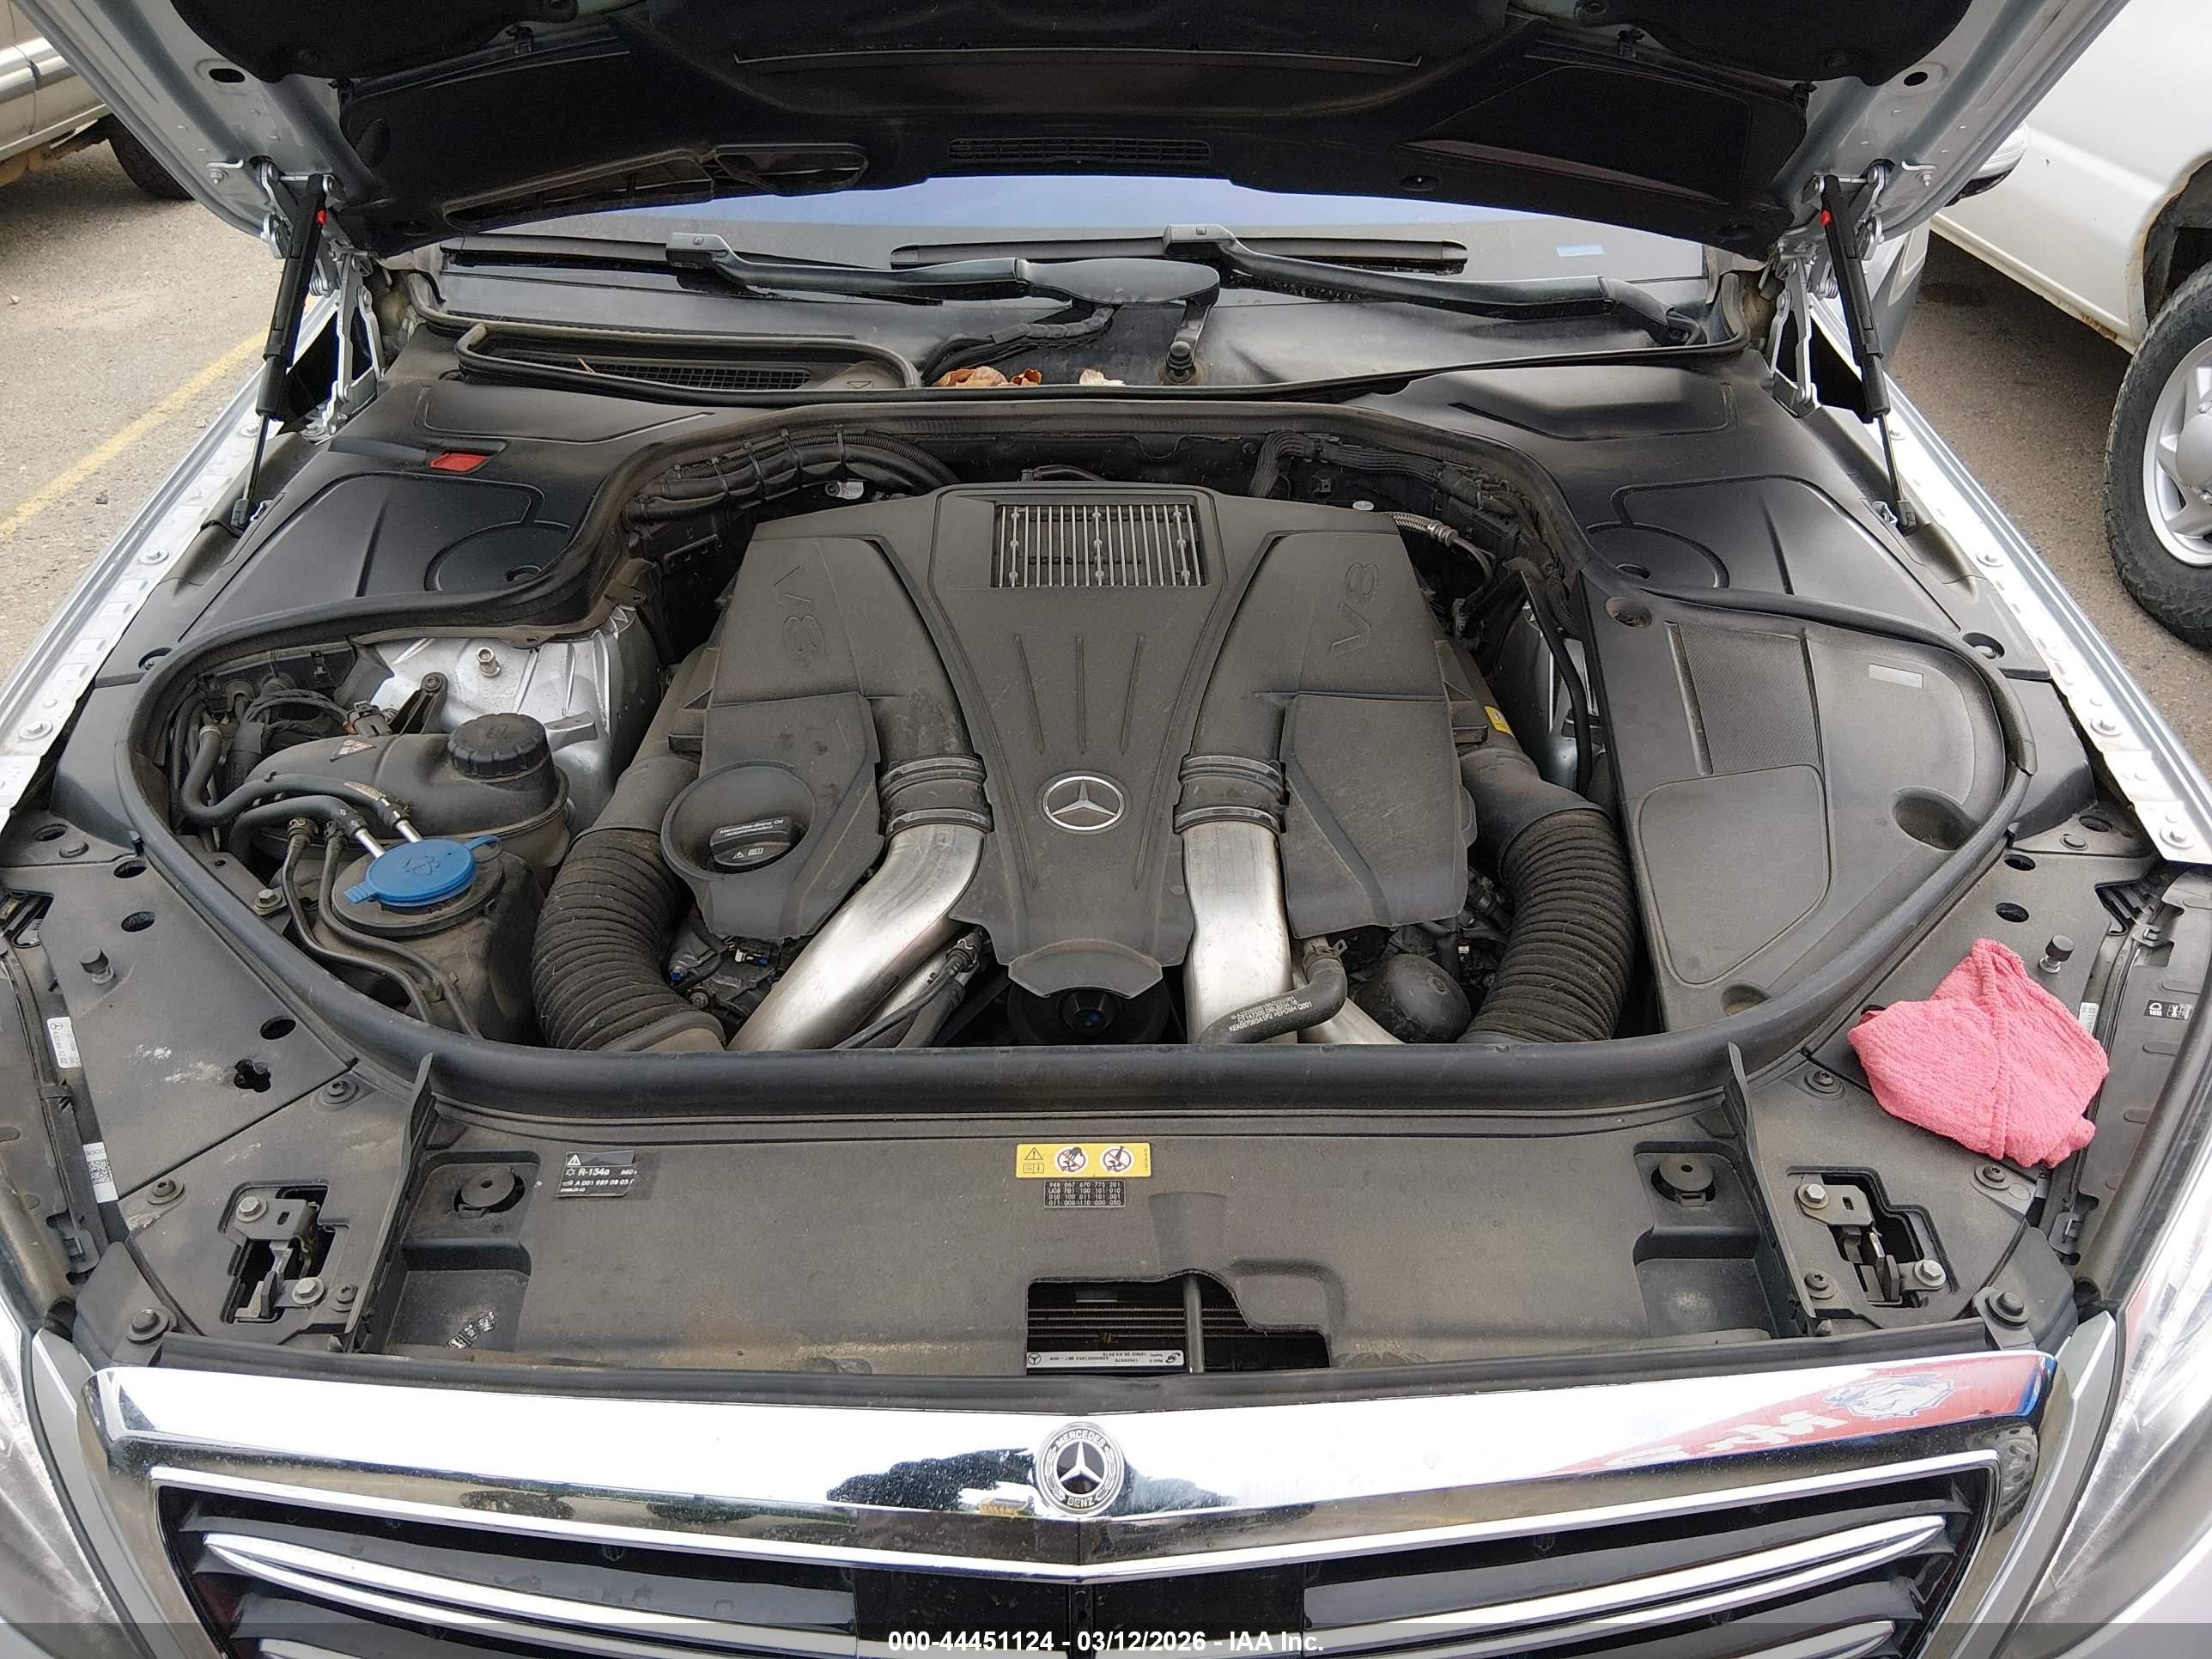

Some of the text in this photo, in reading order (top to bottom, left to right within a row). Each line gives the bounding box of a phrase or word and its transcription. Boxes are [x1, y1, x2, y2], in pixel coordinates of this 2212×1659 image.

[1328, 563, 1379, 659] V8
[720, 821, 772, 834] Mercedes-Benz
[725, 825, 774, 836] recommended
[578, 1168, 610, 1176] R-134a
[1055, 1429, 1106, 1447] MERCEDES
[1066, 1497, 1095, 1508] BENZ
